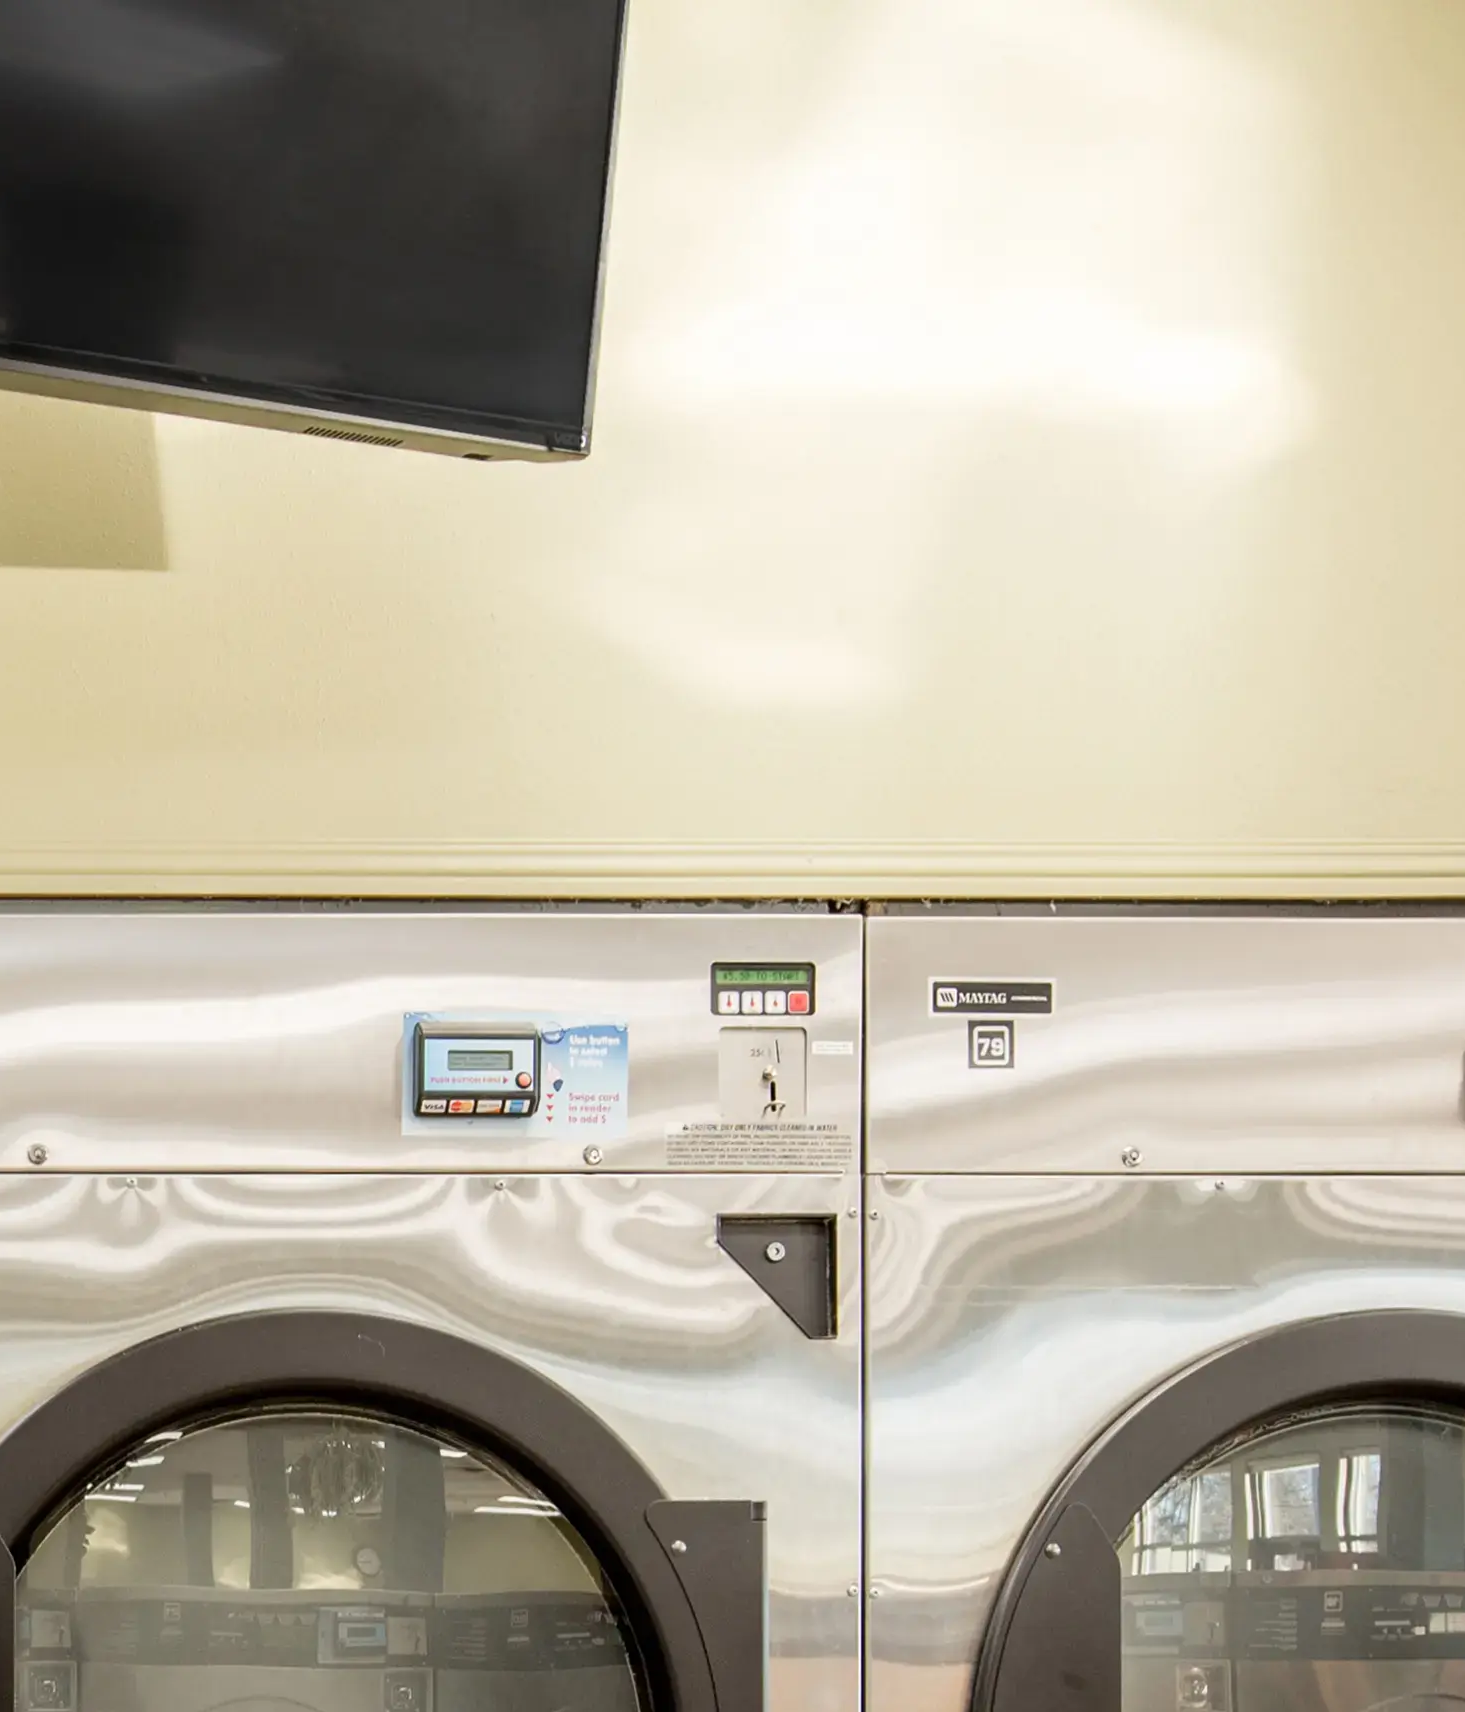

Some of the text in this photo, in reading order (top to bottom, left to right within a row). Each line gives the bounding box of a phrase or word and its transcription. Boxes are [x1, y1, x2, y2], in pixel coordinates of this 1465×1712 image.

[958, 992, 1007, 1004] MAYTAG
[978, 1038, 1004, 1057] 79
[569, 1092, 619, 1104] Swipe card
[569, 1104, 578, 1112] in
[569, 1115, 578, 1123] to
[580, 1115, 599, 1123] add
